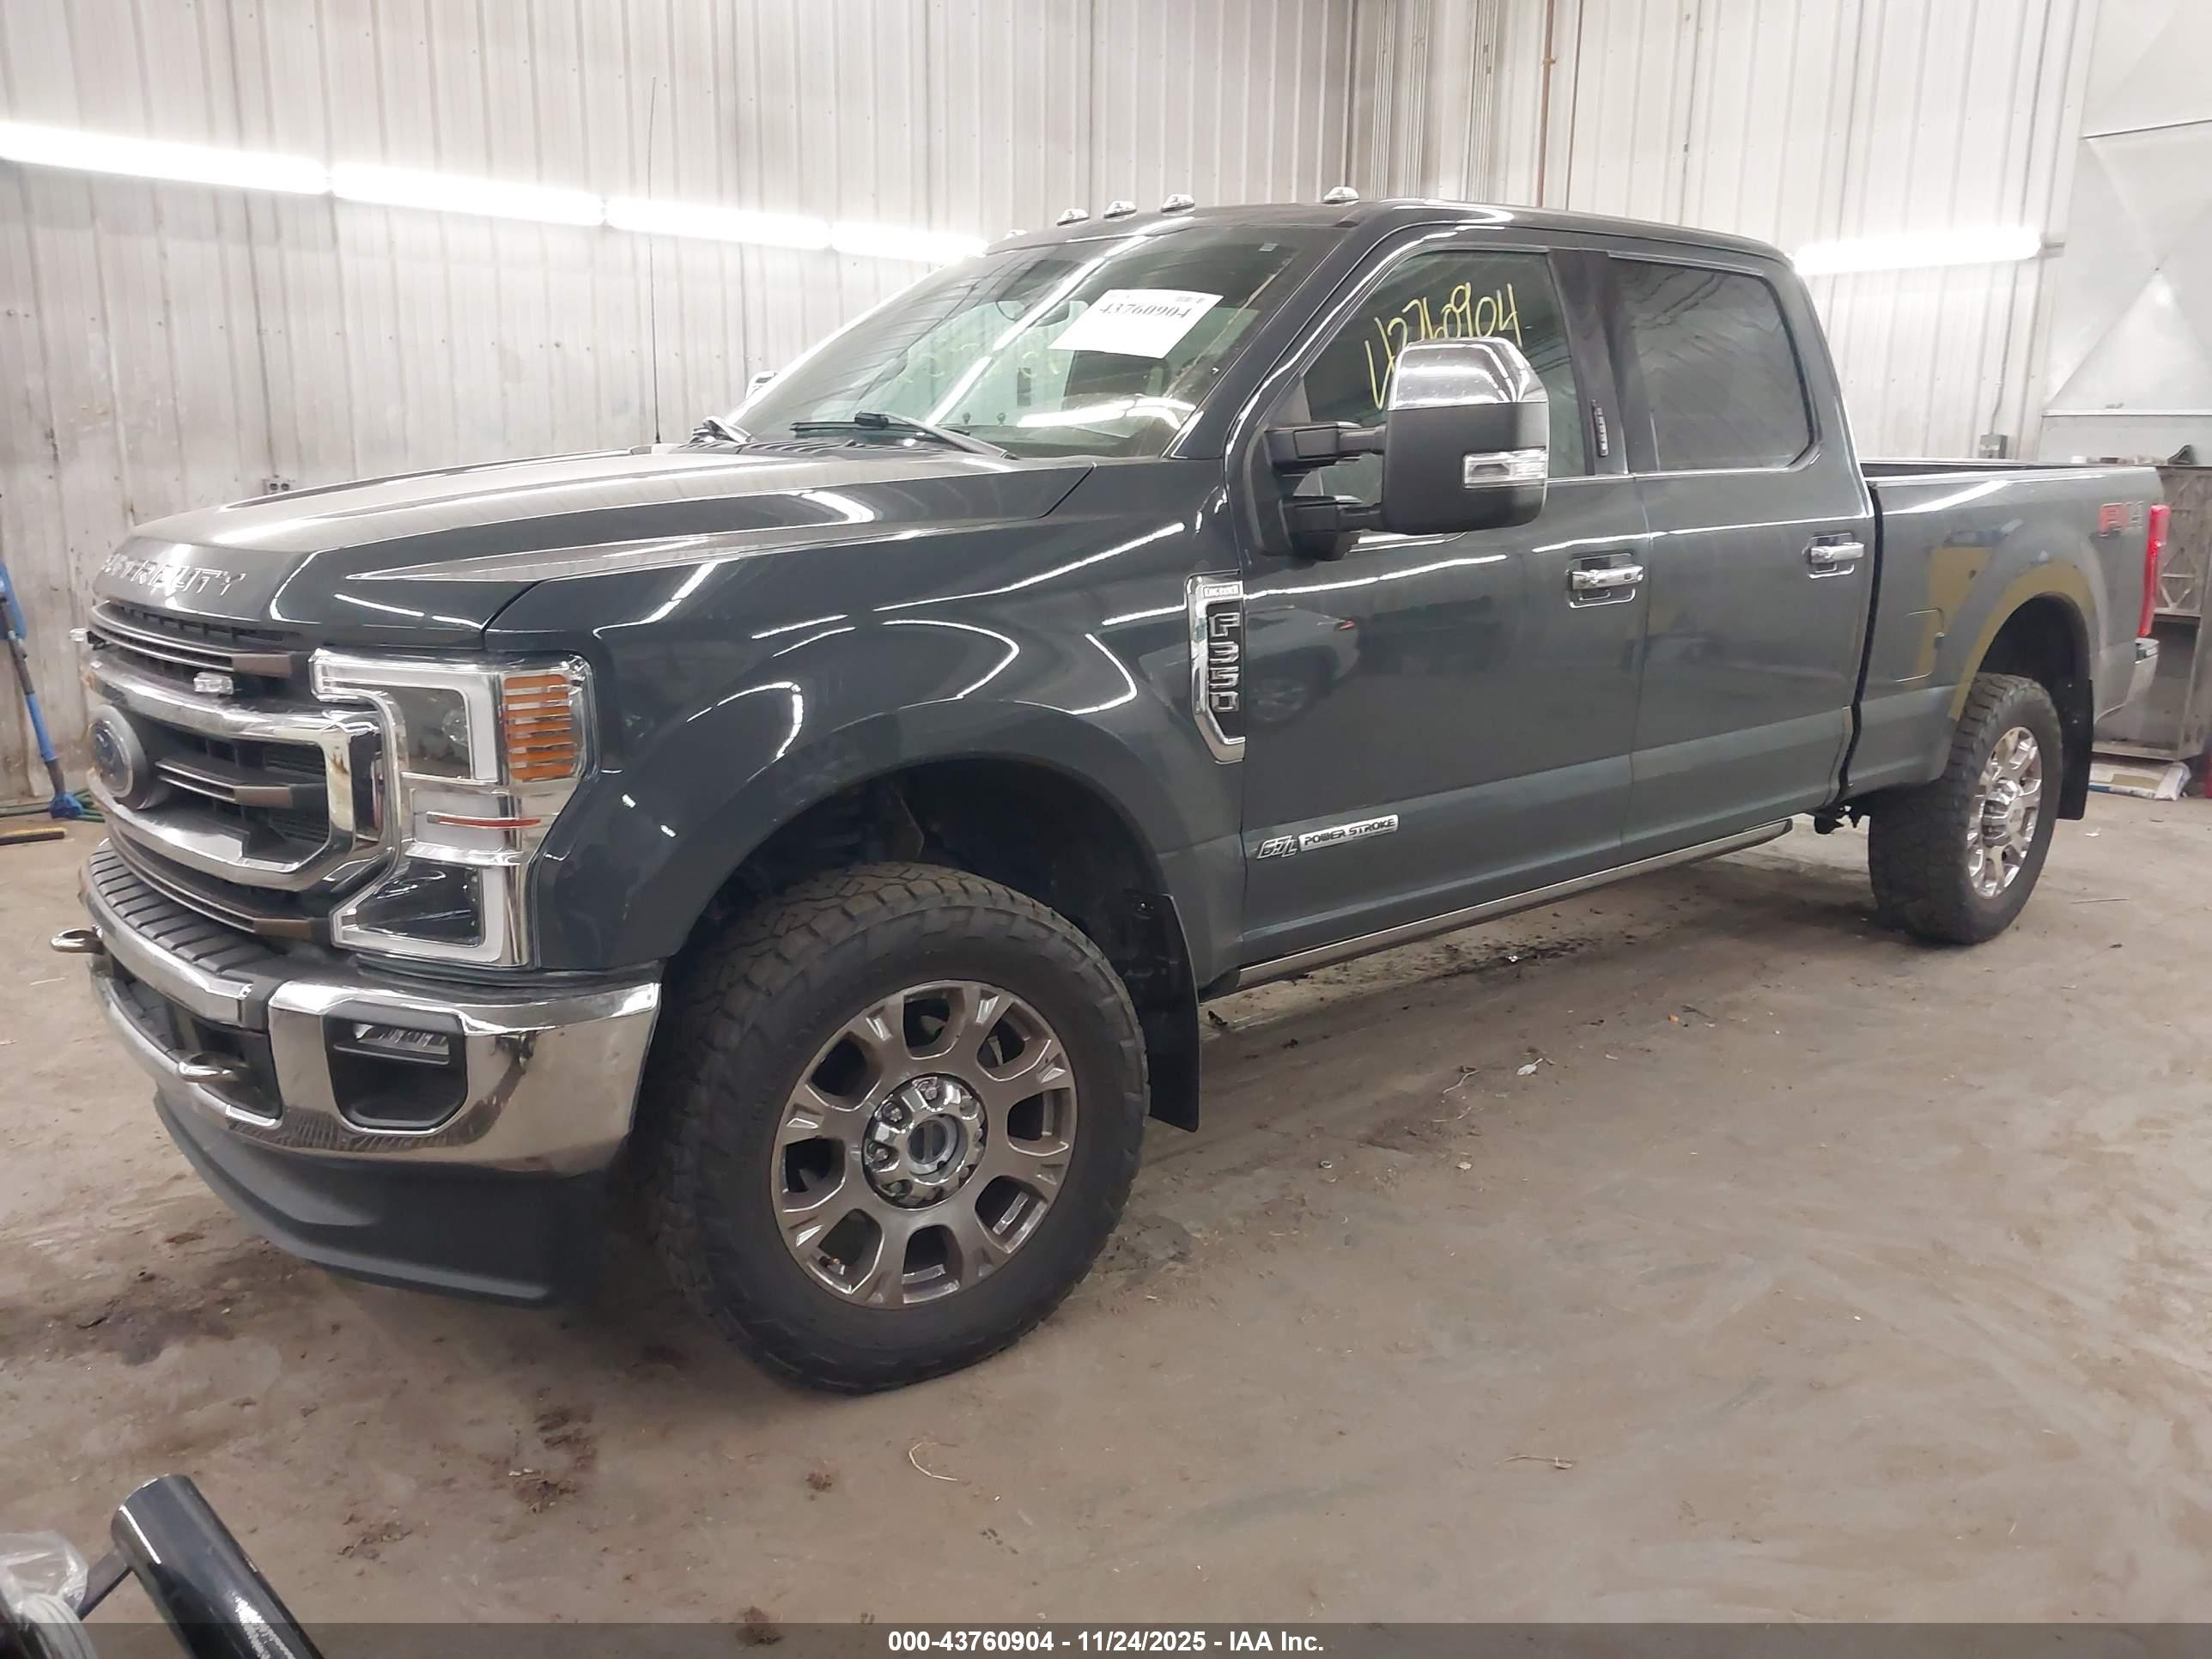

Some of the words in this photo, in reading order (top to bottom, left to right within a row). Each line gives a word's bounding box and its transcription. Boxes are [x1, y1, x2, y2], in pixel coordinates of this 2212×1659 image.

[1099, 302, 1193, 319] 43760904
[1304, 830, 1346, 846] POWER
[1348, 818, 1395, 836] STROKE
